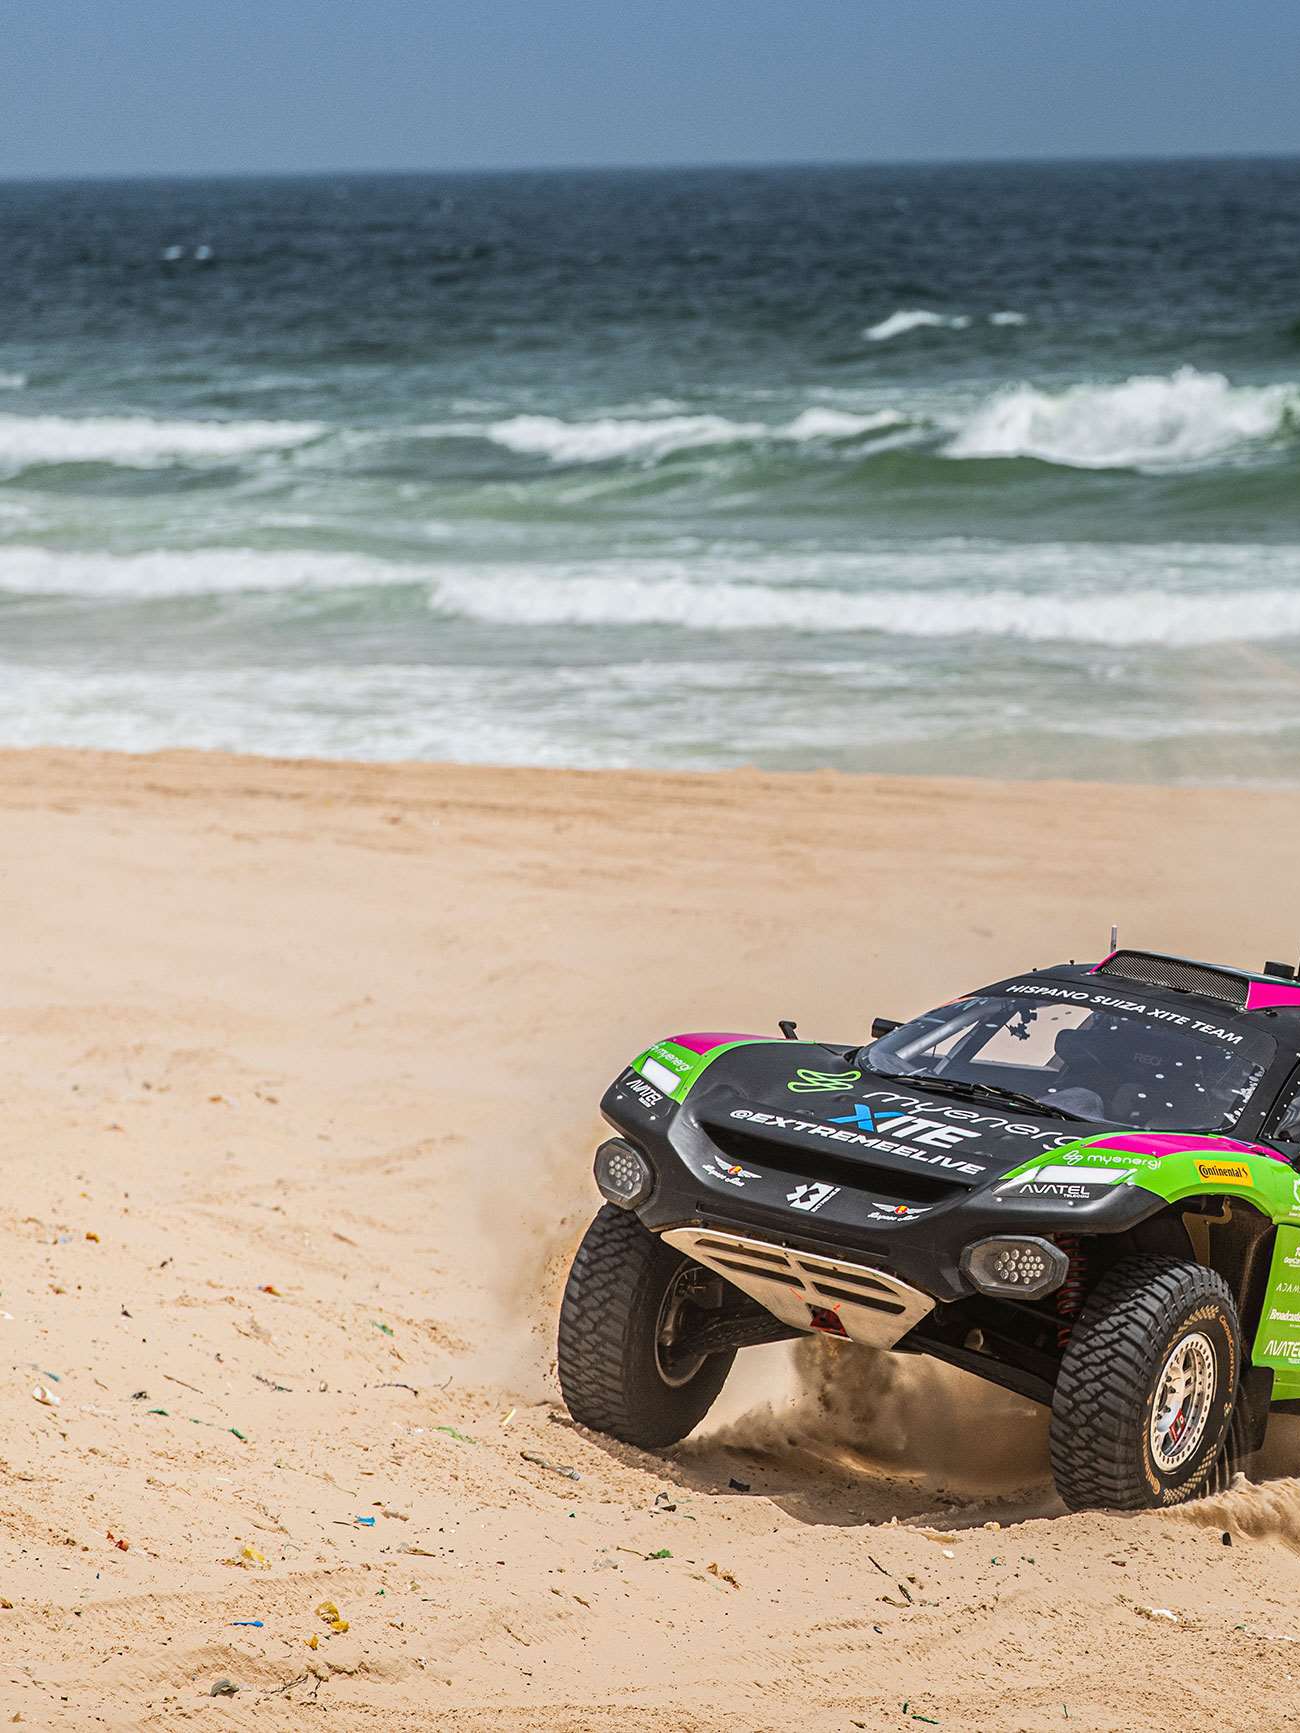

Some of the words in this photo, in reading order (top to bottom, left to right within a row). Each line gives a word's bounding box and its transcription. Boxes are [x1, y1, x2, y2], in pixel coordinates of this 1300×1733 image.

[1006, 985, 1089, 1000] HISPANO
[1090, 996, 1147, 1014] SUIZA
[1147, 1008, 1191, 1026] XITE
[1191, 1020, 1244, 1045] TEAM
[730, 1109, 987, 1175] @EXTREMEELIVE
[826, 1103, 983, 1149] XITE
[862, 1091, 1083, 1150] myenerg
[1088, 1154, 1162, 1169] myenergi
[1198, 1164, 1242, 1179] Continental
[1019, 1184, 1090, 1195] AVATEL
